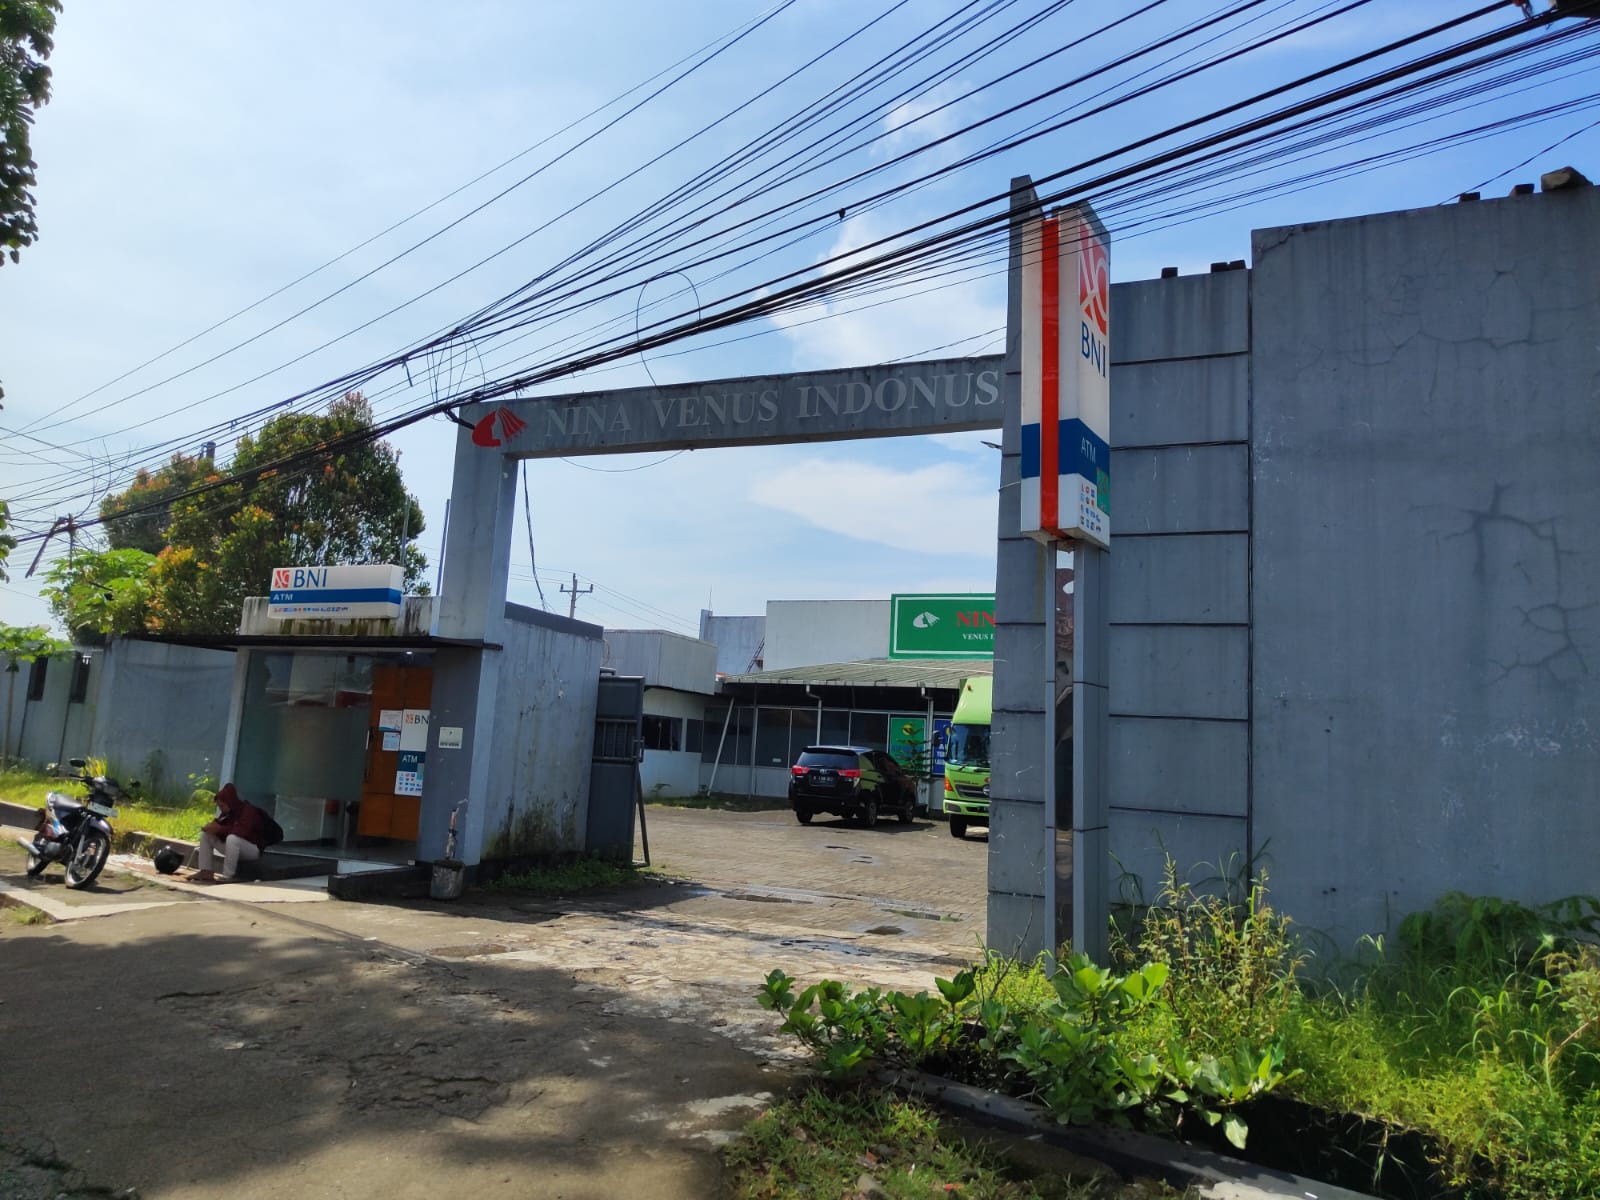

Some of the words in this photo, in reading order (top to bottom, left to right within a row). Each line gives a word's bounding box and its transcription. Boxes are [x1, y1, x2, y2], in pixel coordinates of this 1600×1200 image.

[1081, 319, 1107, 379] BNI
[545, 403, 633, 438] NINA
[652, 389, 779, 429] VENUS
[797, 370, 1005, 419] INDONUS
[1080, 436, 1096, 465] ATM
[293, 568, 328, 589] BNI
[272, 592, 294, 602] ATM
[962, 633, 989, 641] VENUS
[401, 754, 418, 763] ATM
